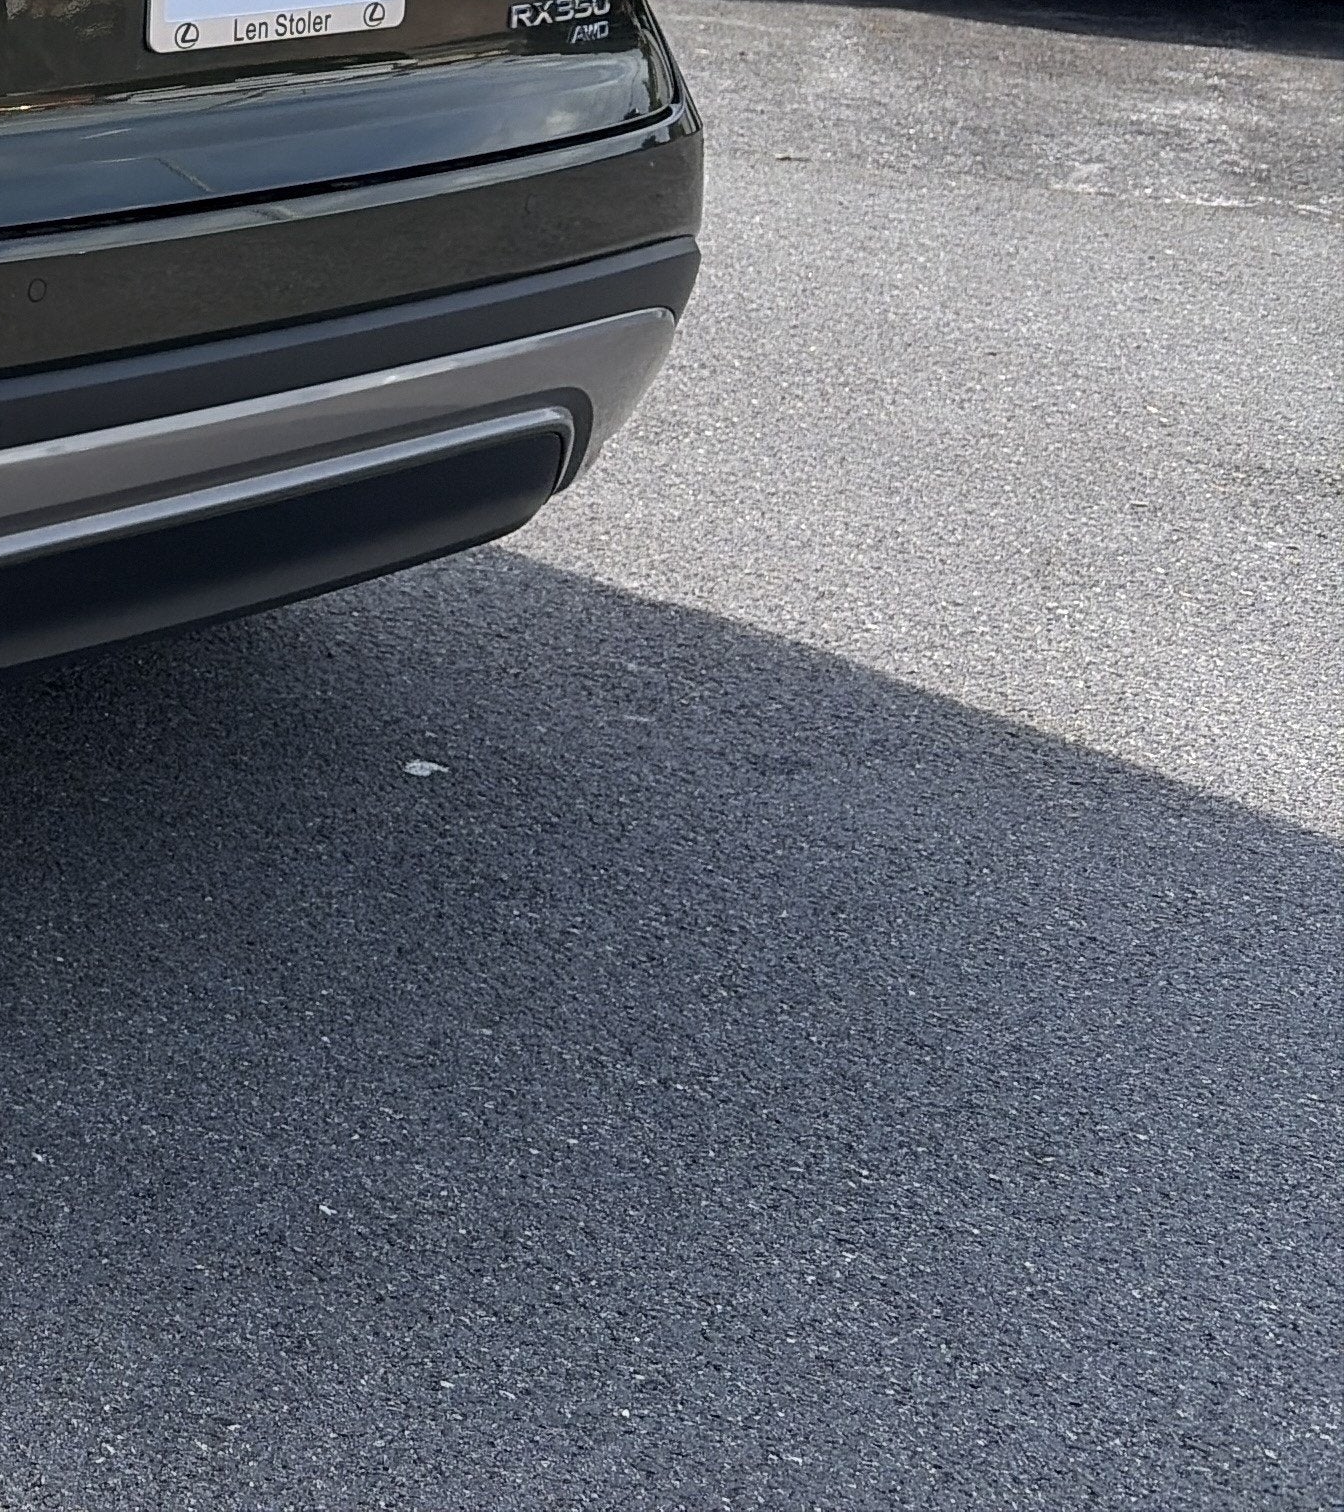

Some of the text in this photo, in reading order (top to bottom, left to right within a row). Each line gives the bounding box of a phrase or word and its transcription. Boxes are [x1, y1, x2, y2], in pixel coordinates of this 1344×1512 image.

[233, 11, 332, 42] Len Stoler
[569, 20, 609, 44] AWD
